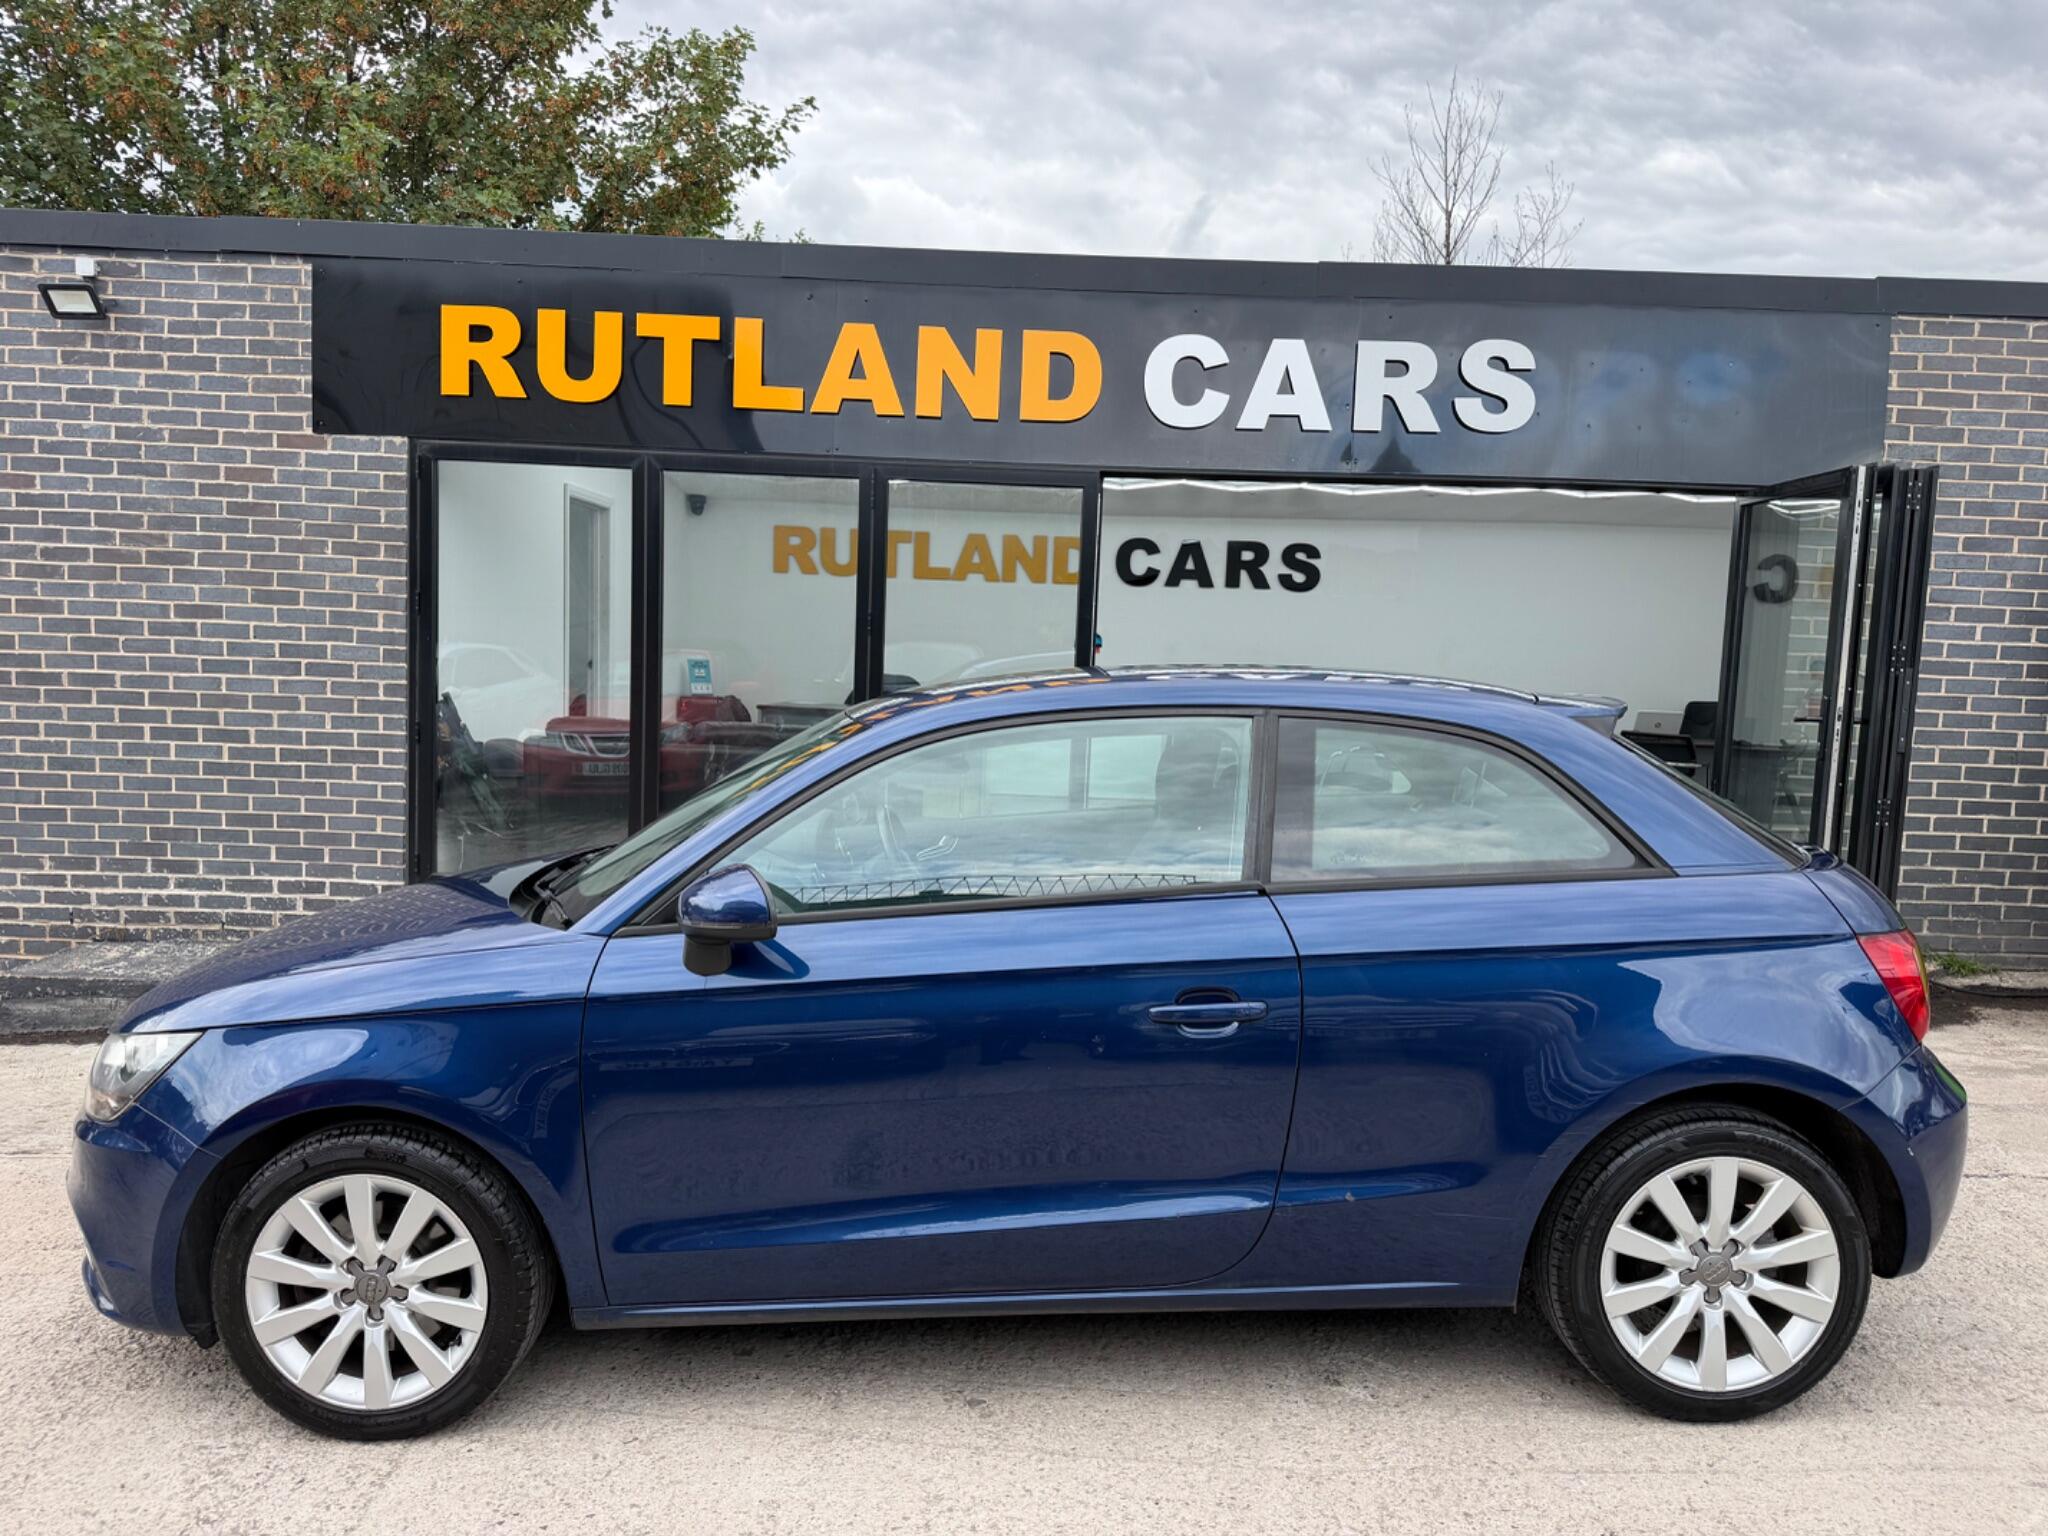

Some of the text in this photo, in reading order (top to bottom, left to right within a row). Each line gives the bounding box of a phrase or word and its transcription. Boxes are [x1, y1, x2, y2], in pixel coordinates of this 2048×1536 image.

[440, 304, 1103, 423] RUTLAND
[1143, 334, 1537, 434] CARS
[1115, 537, 1322, 592] CARS
